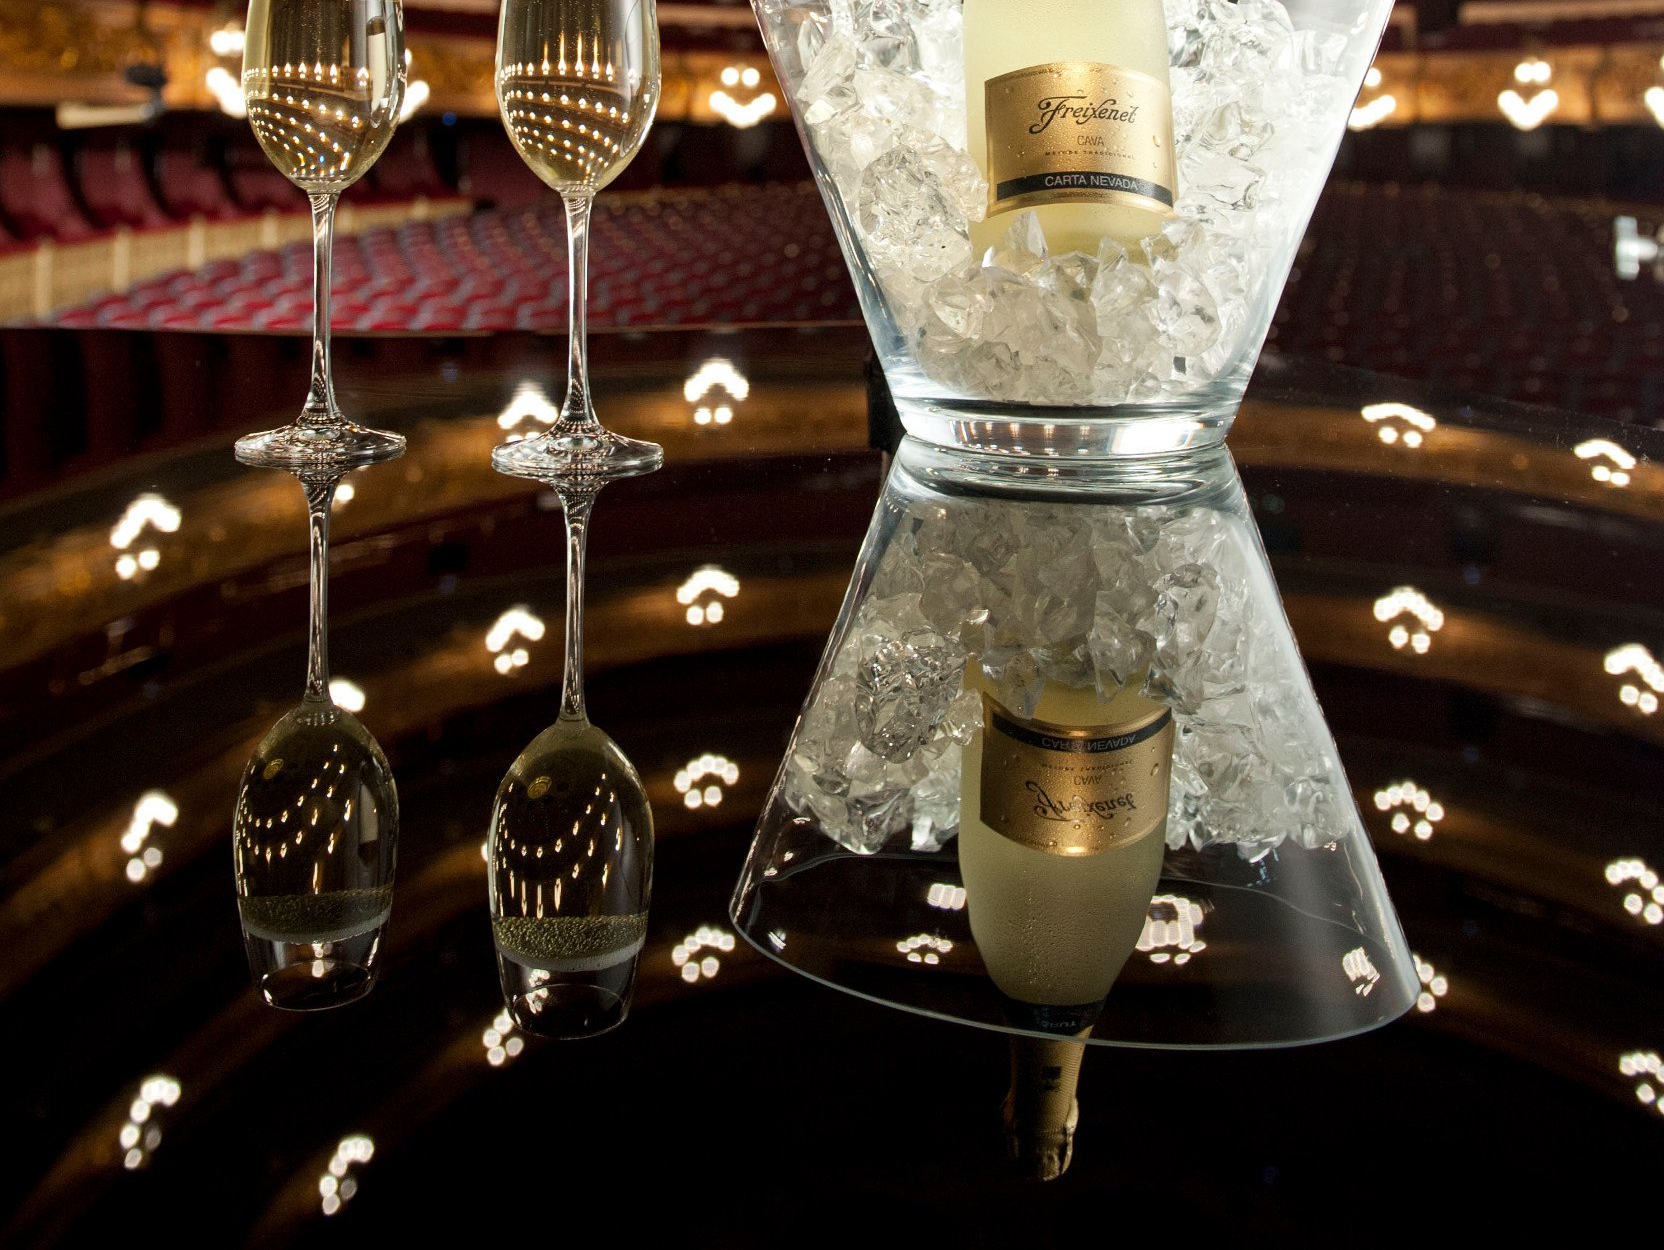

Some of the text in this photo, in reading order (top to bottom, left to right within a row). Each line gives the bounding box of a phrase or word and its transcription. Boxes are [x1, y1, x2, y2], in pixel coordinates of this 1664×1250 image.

[1028, 95, 1139, 134] Freixenet
[1077, 135, 1105, 147] CAVA
[1044, 175, 1139, 190] CARTA NEVADA
